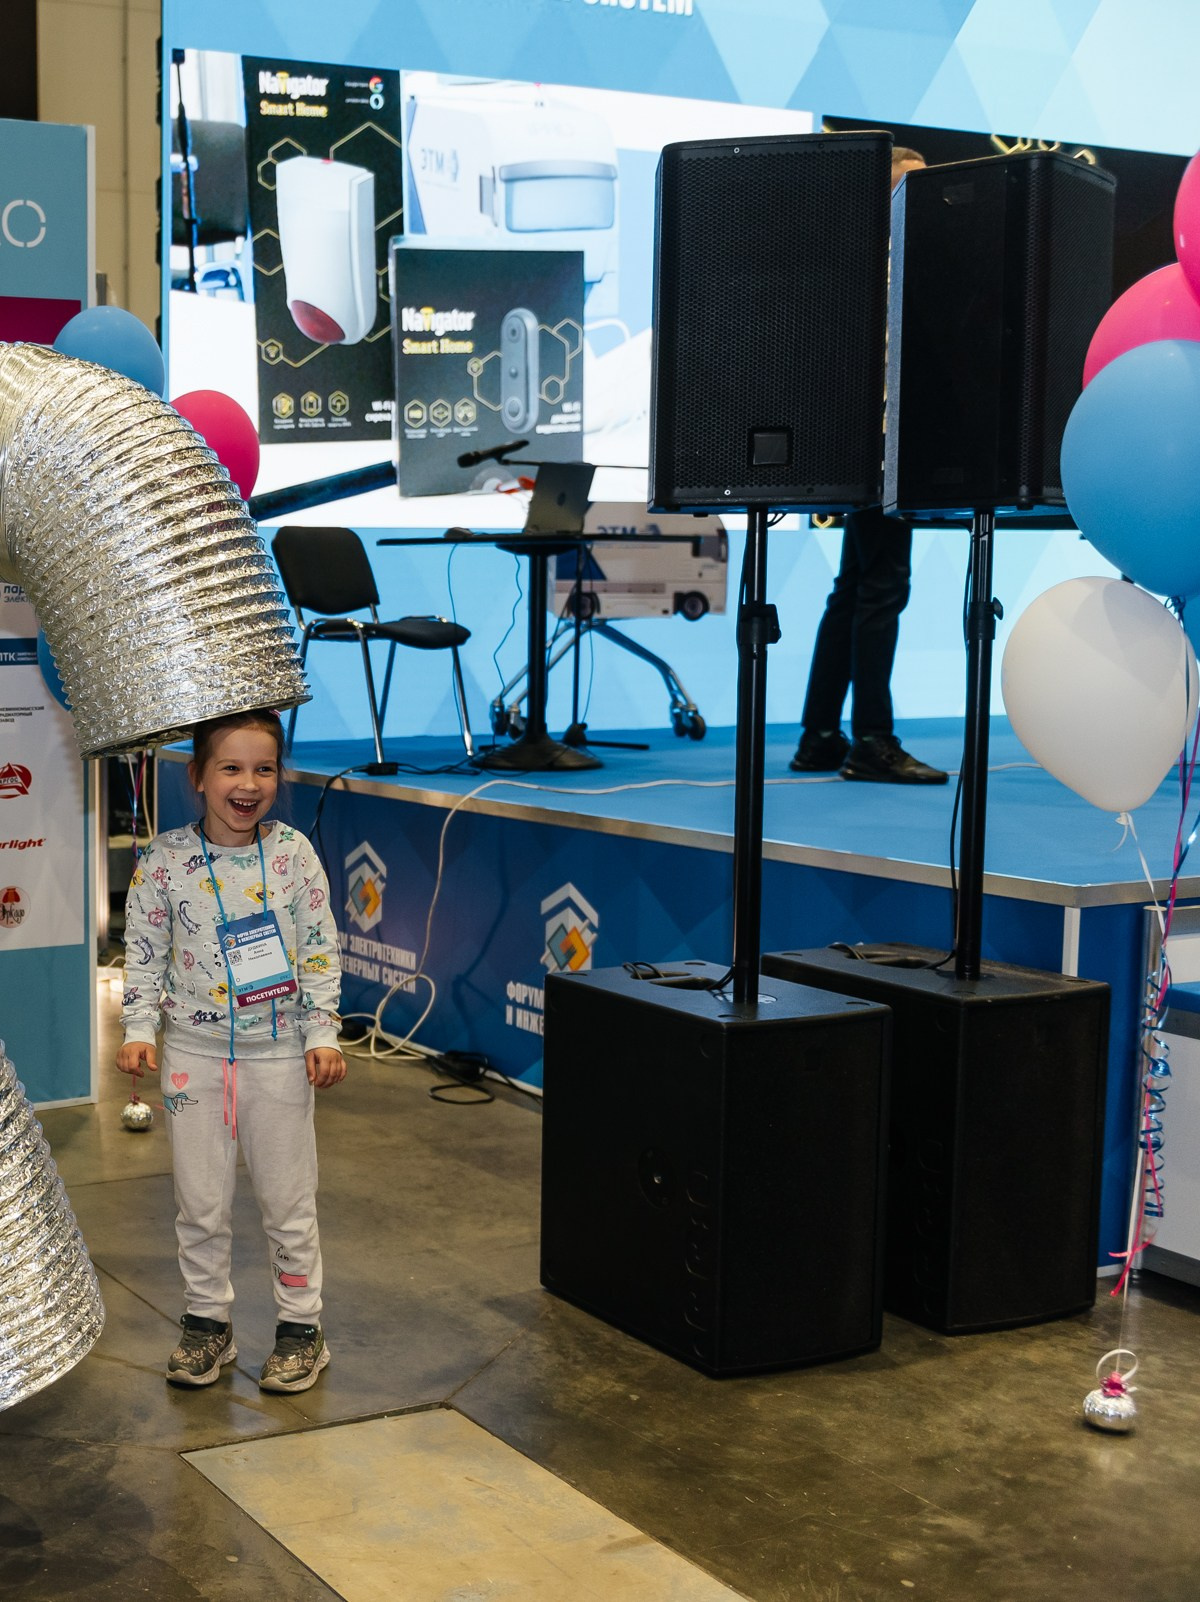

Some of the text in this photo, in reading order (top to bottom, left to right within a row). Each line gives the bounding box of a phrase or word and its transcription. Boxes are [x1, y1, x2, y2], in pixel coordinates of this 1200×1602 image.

[349, 934, 416, 970] ЭЛЕКТРОТЕХНИКИ
[246, 986, 290, 1003] ПОСЕТИТЕЛЬ
[506, 980, 544, 1010] ФОРУМ
[506, 1004, 513, 1026] И
